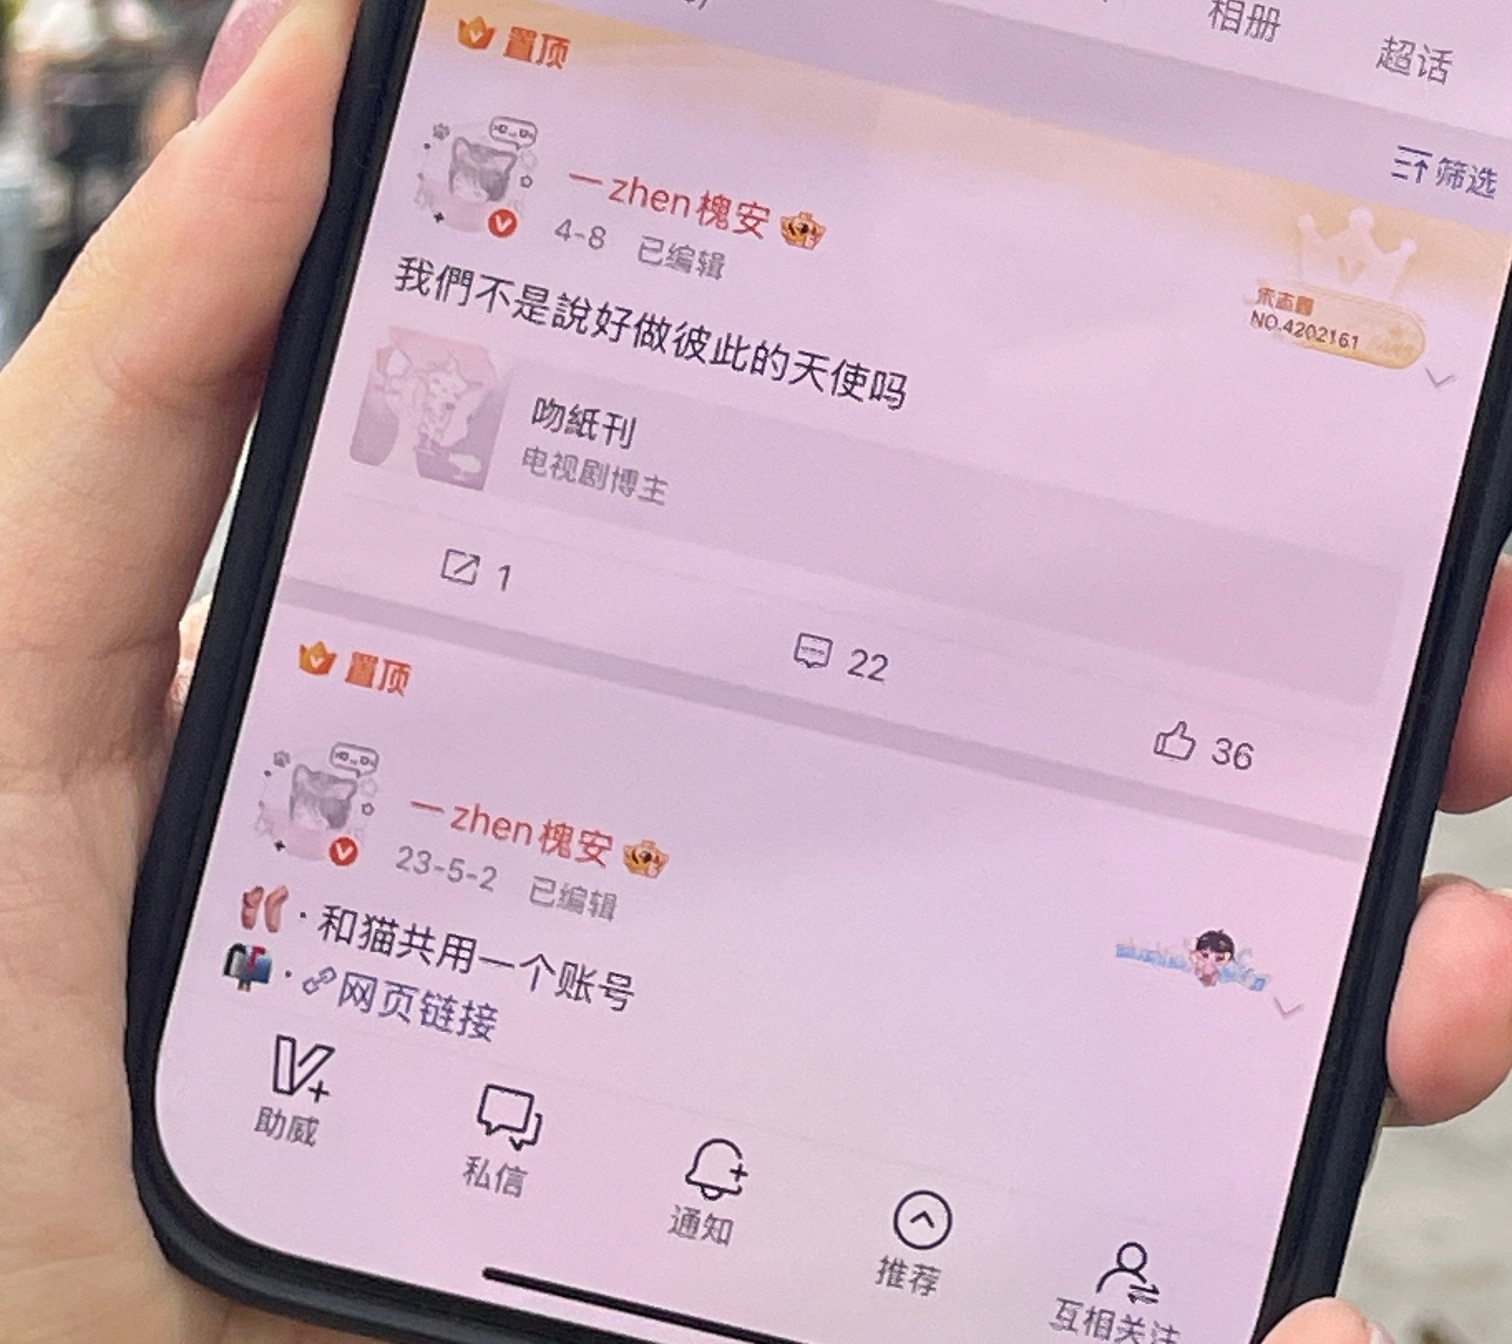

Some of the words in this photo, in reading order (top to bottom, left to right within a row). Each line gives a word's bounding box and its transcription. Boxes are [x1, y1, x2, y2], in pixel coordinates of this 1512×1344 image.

[503, 25, 572, 70] 置顶
[1375, 35, 1454, 86] 超话
[1435, 155, 1499, 201] 筛选
[554, 218, 608, 251] 4-8
[637, 234, 728, 282] 已编辑
[394, 254, 908, 412] 我們不是說好做彼此的天使吗
[531, 396, 637, 450] 吻紙刊
[521, 445, 670, 508] 电视剧博主
[497, 564, 512, 593] 1
[344, 650, 412, 697] 置顶
[846, 648, 890, 683] 22
[1211, 737, 1255, 772] 36
[394, 844, 499, 893] 23-5-2
[528, 875, 618, 924] 已编辑
[317, 904, 635, 1013] 和猫共用一个账号
[337, 971, 500, 1043] 网页链接
[253, 1105, 320, 1148] 助威
[462, 1155, 528, 1199] 私信
[667, 1204, 734, 1248] 通知
[874, 1255, 942, 1299] 推荐
[1048, 1296, 1182, 1344] 互相关注
